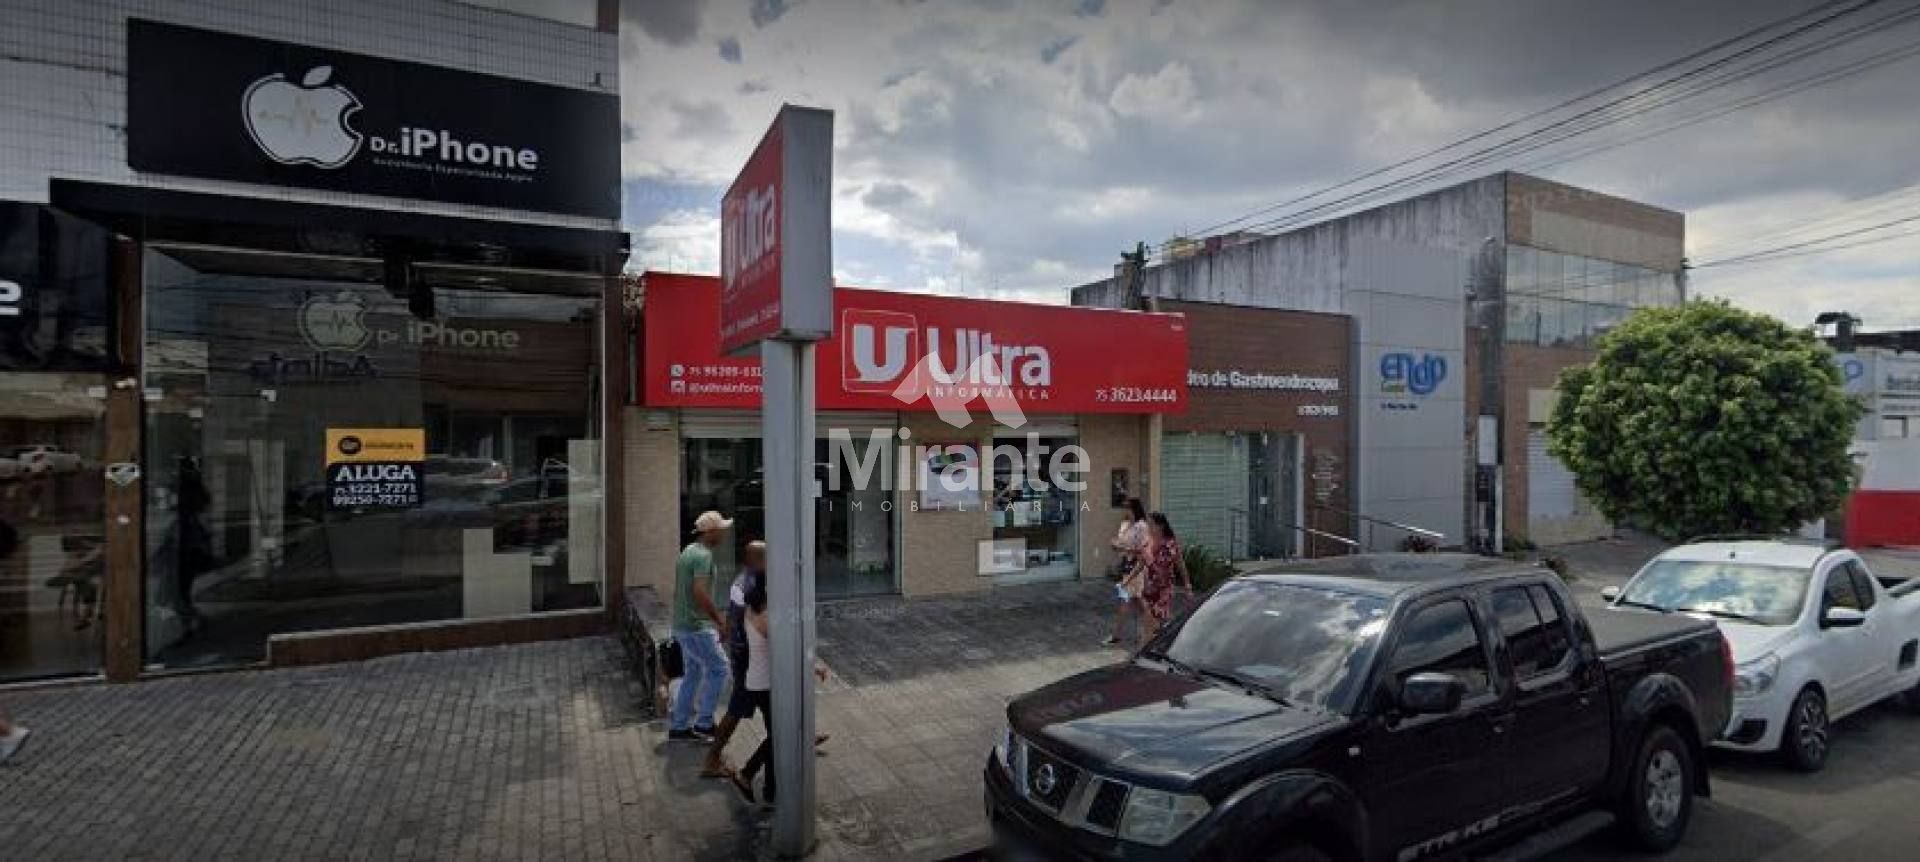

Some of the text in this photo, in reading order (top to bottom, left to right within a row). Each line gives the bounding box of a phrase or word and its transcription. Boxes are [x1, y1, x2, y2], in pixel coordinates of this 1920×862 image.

[401, 127, 538, 170] iPhone
[740, 183, 775, 271] Ultra
[408, 320, 521, 349] iPhone
[926, 327, 1051, 386] Ultra
[1211, 371, 1228, 386] de
[335, 465, 417, 481] ALUGA
